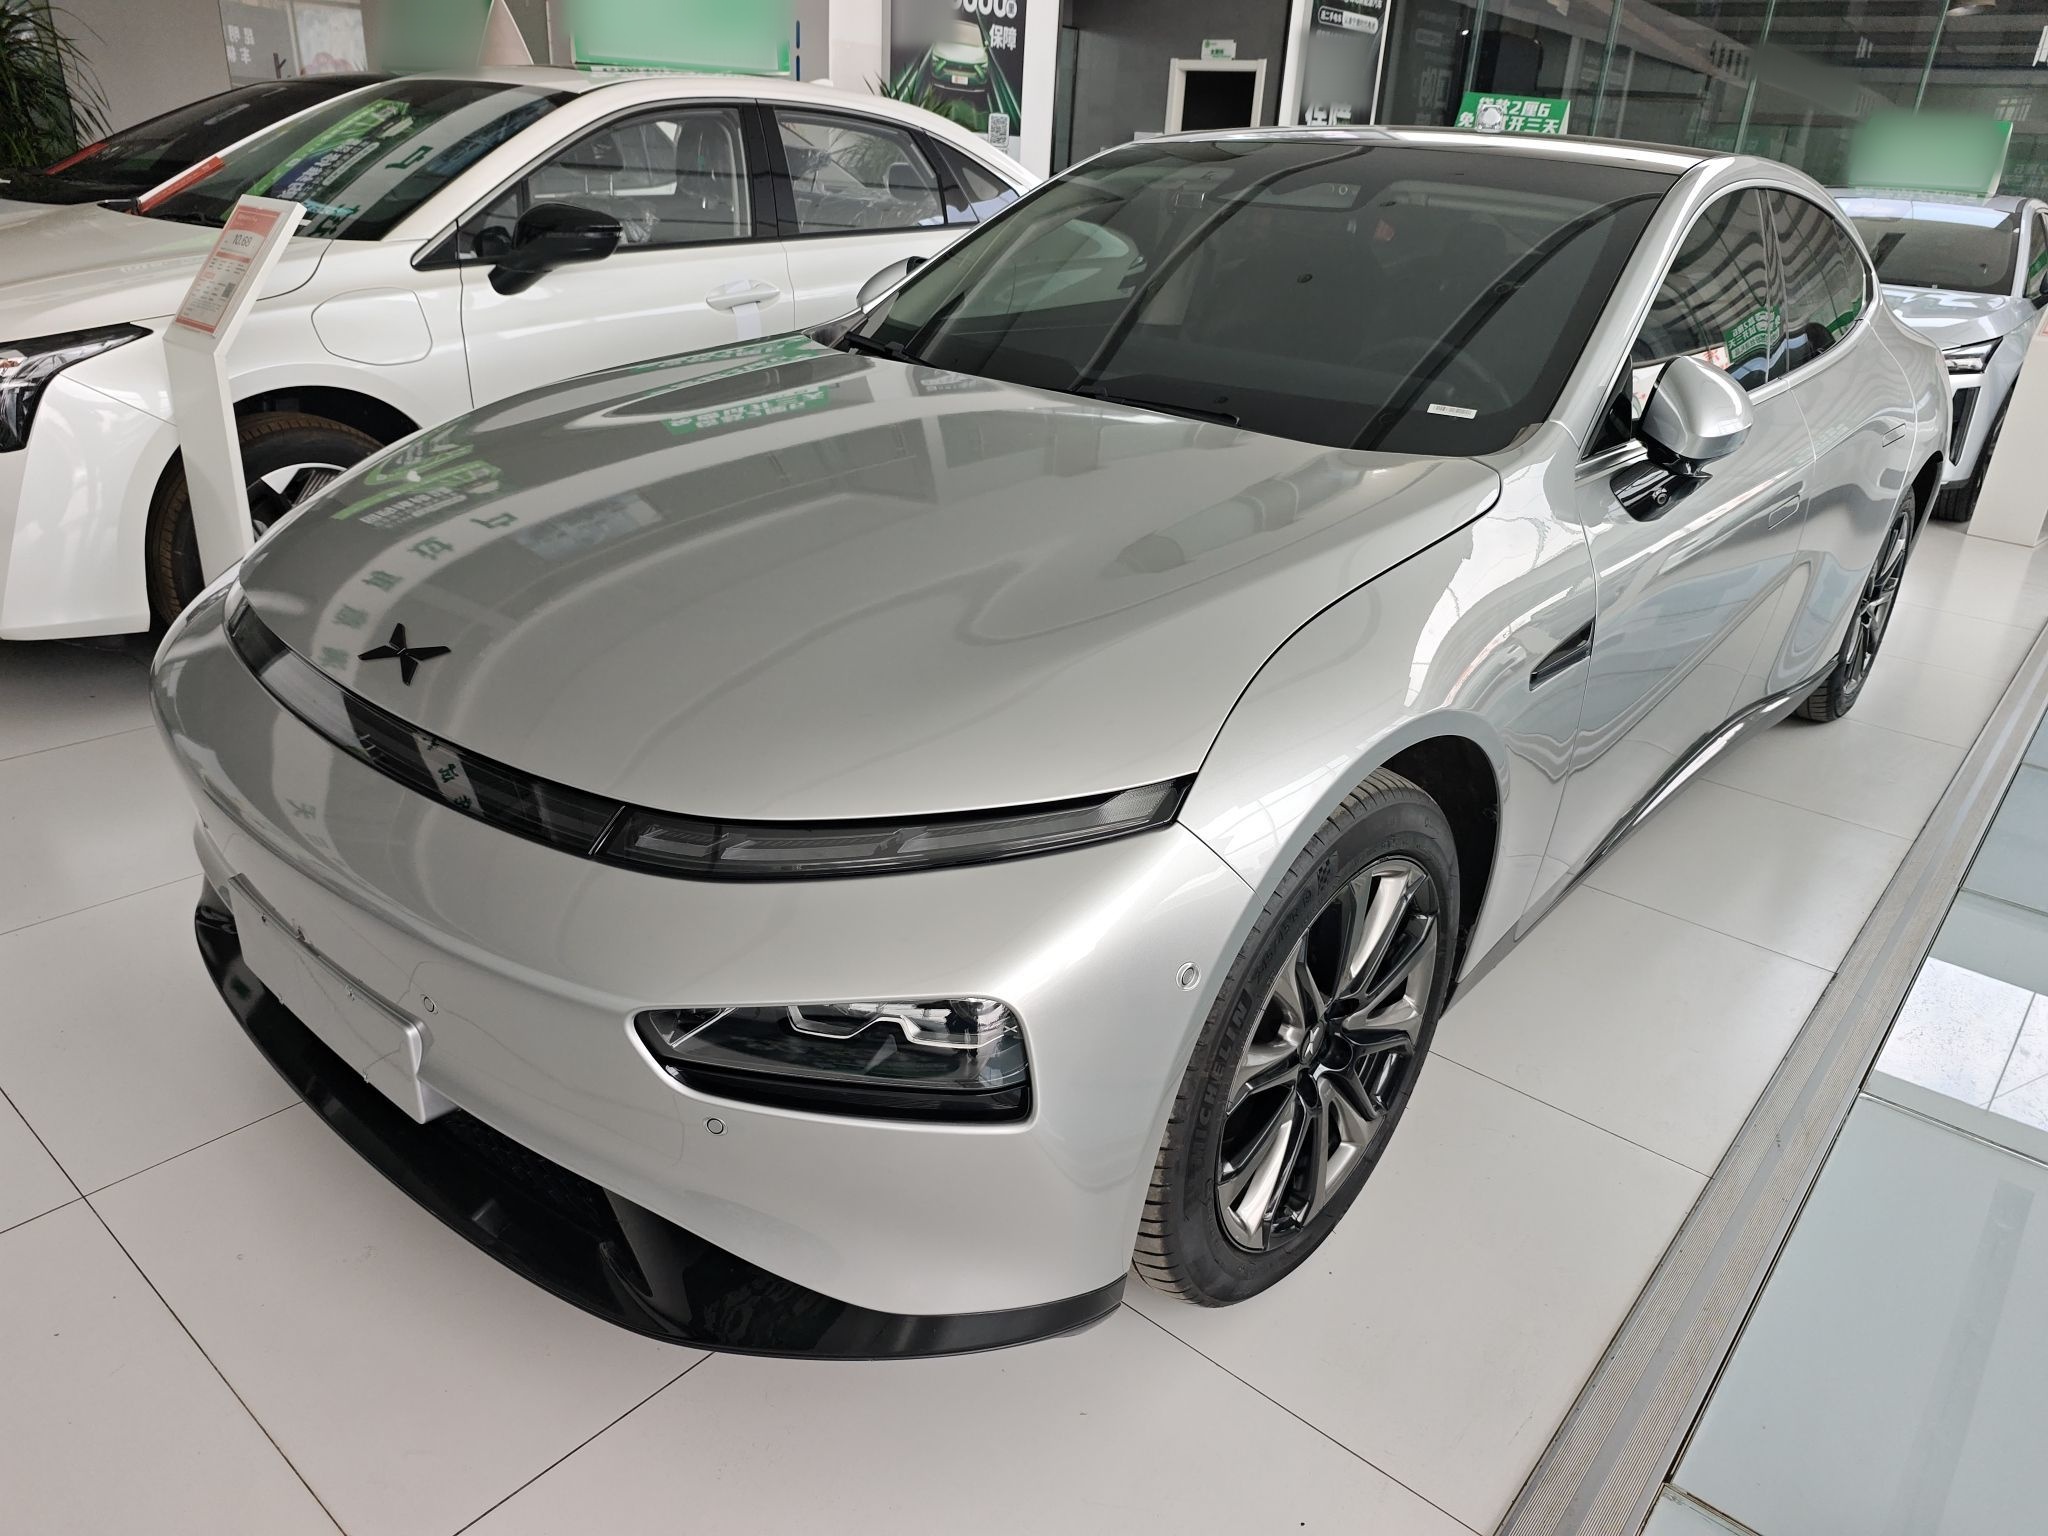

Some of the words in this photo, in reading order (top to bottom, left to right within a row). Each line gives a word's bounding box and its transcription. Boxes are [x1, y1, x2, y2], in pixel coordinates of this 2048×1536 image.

[989, 23, 1017, 51] 保障
[1457, 111, 1560, 135] 免开三天
[1190, 1001, 1250, 1166] MICHELIN
